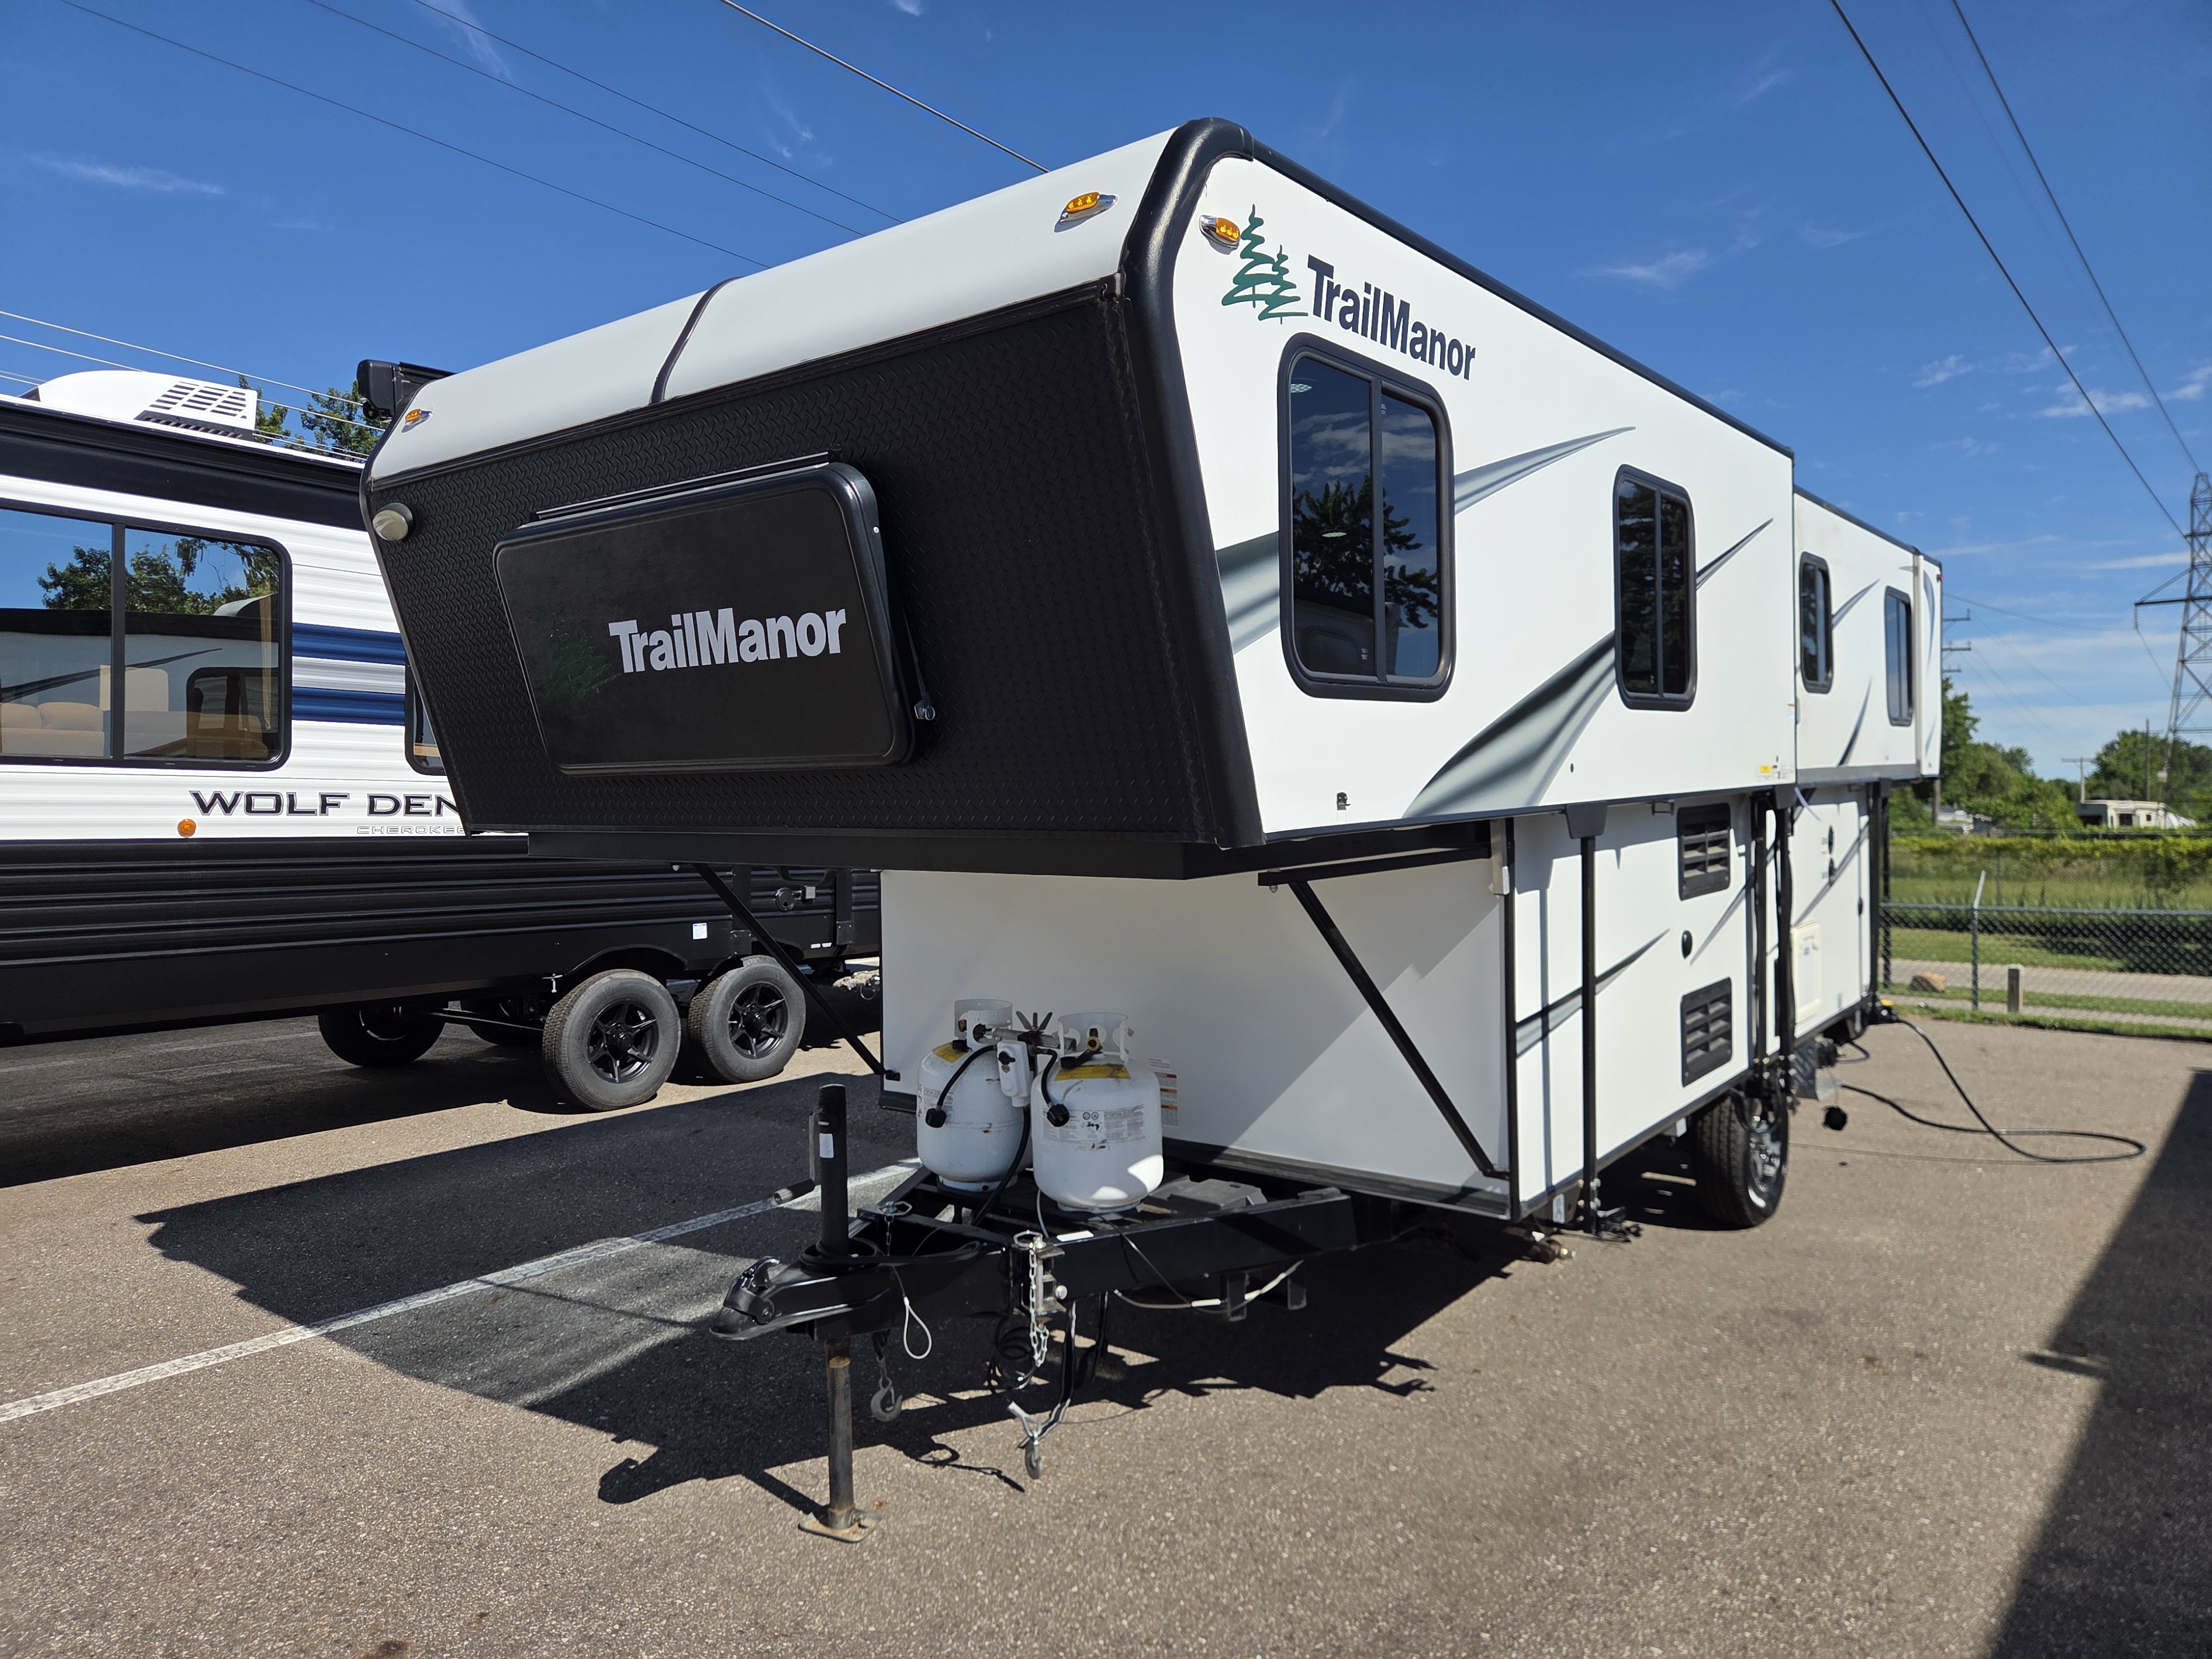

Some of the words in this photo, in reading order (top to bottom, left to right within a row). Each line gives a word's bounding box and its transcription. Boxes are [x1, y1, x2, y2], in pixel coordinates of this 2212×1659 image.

[1307, 254, 1476, 380] TrailManor
[608, 607, 847, 673] TrailManor
[189, 790, 350, 816] WOLF
